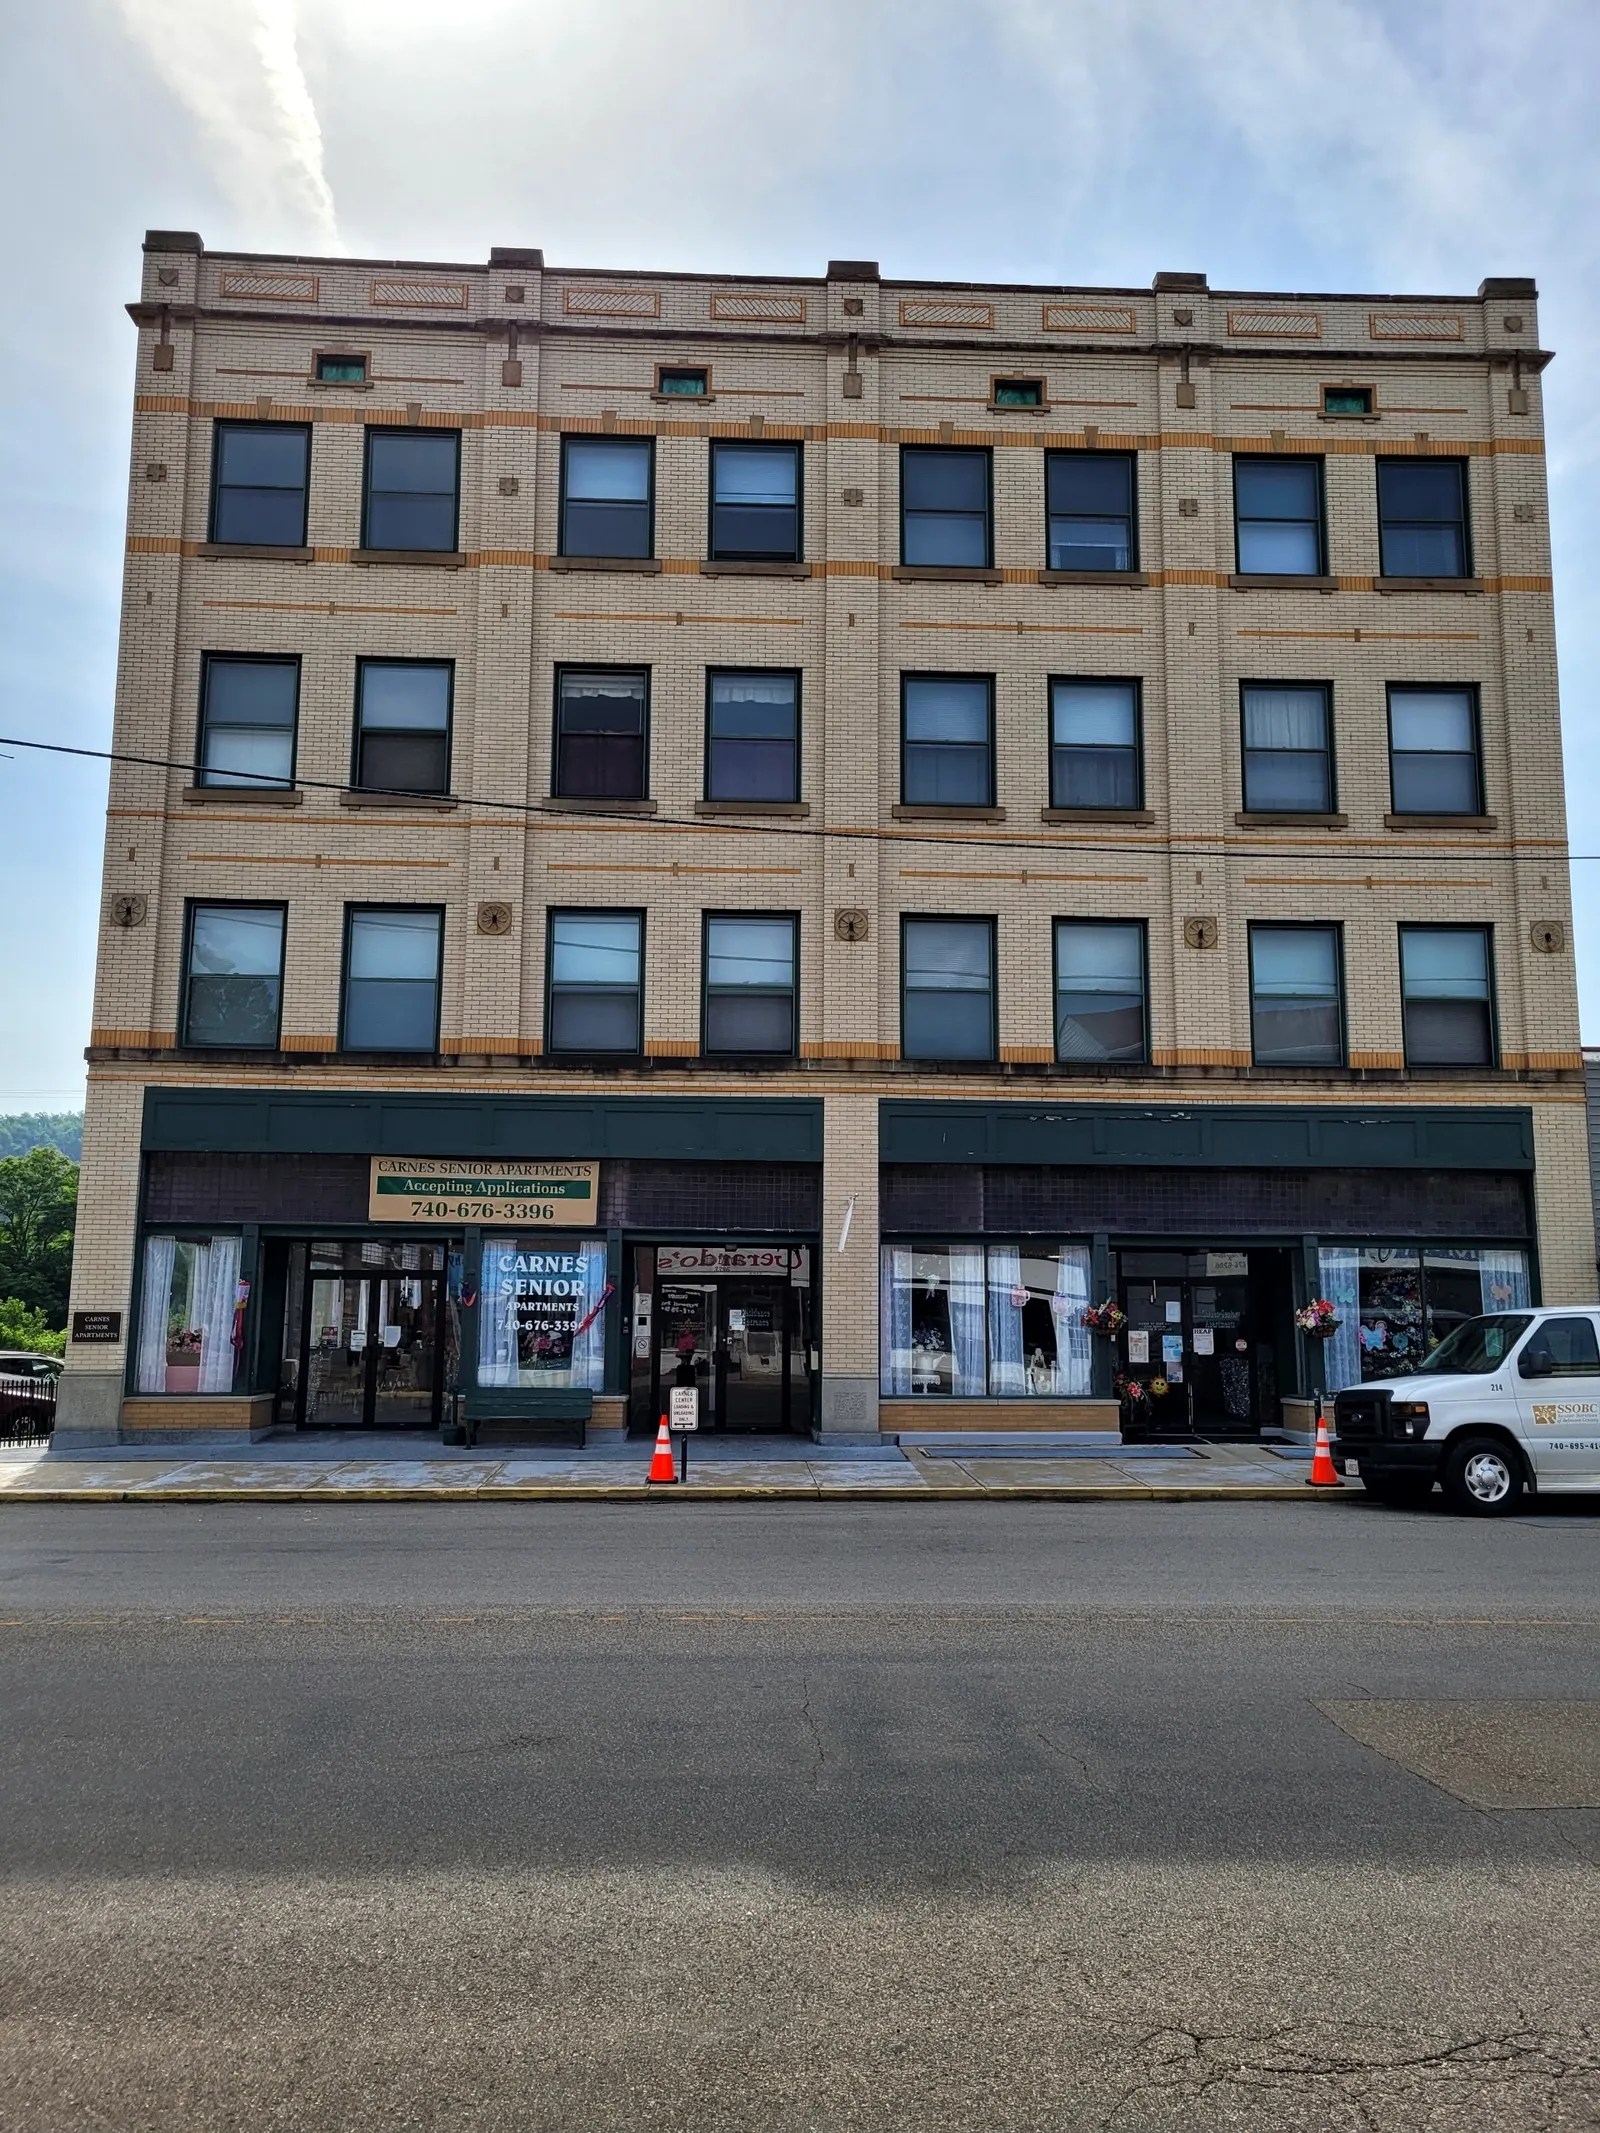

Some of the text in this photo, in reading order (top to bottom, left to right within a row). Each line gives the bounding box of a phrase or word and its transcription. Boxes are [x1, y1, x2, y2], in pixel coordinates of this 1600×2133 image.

[378, 1160, 592, 1177] CARNES SENIOR APARTMENTS
[403, 1179, 565, 1196] Accepting Applications
[411, 1201, 554, 1220] 740-676-3396
[499, 1255, 589, 1273] CARNES
[500, 1279, 585, 1296] SENIOR
[505, 1302, 580, 1312] APARTMENTS
[1491, 1383, 1503, 1391] 214
[1557, 1403, 1598, 1413] SSOBC
[1549, 1442, 1600, 1450] 740-695-41
